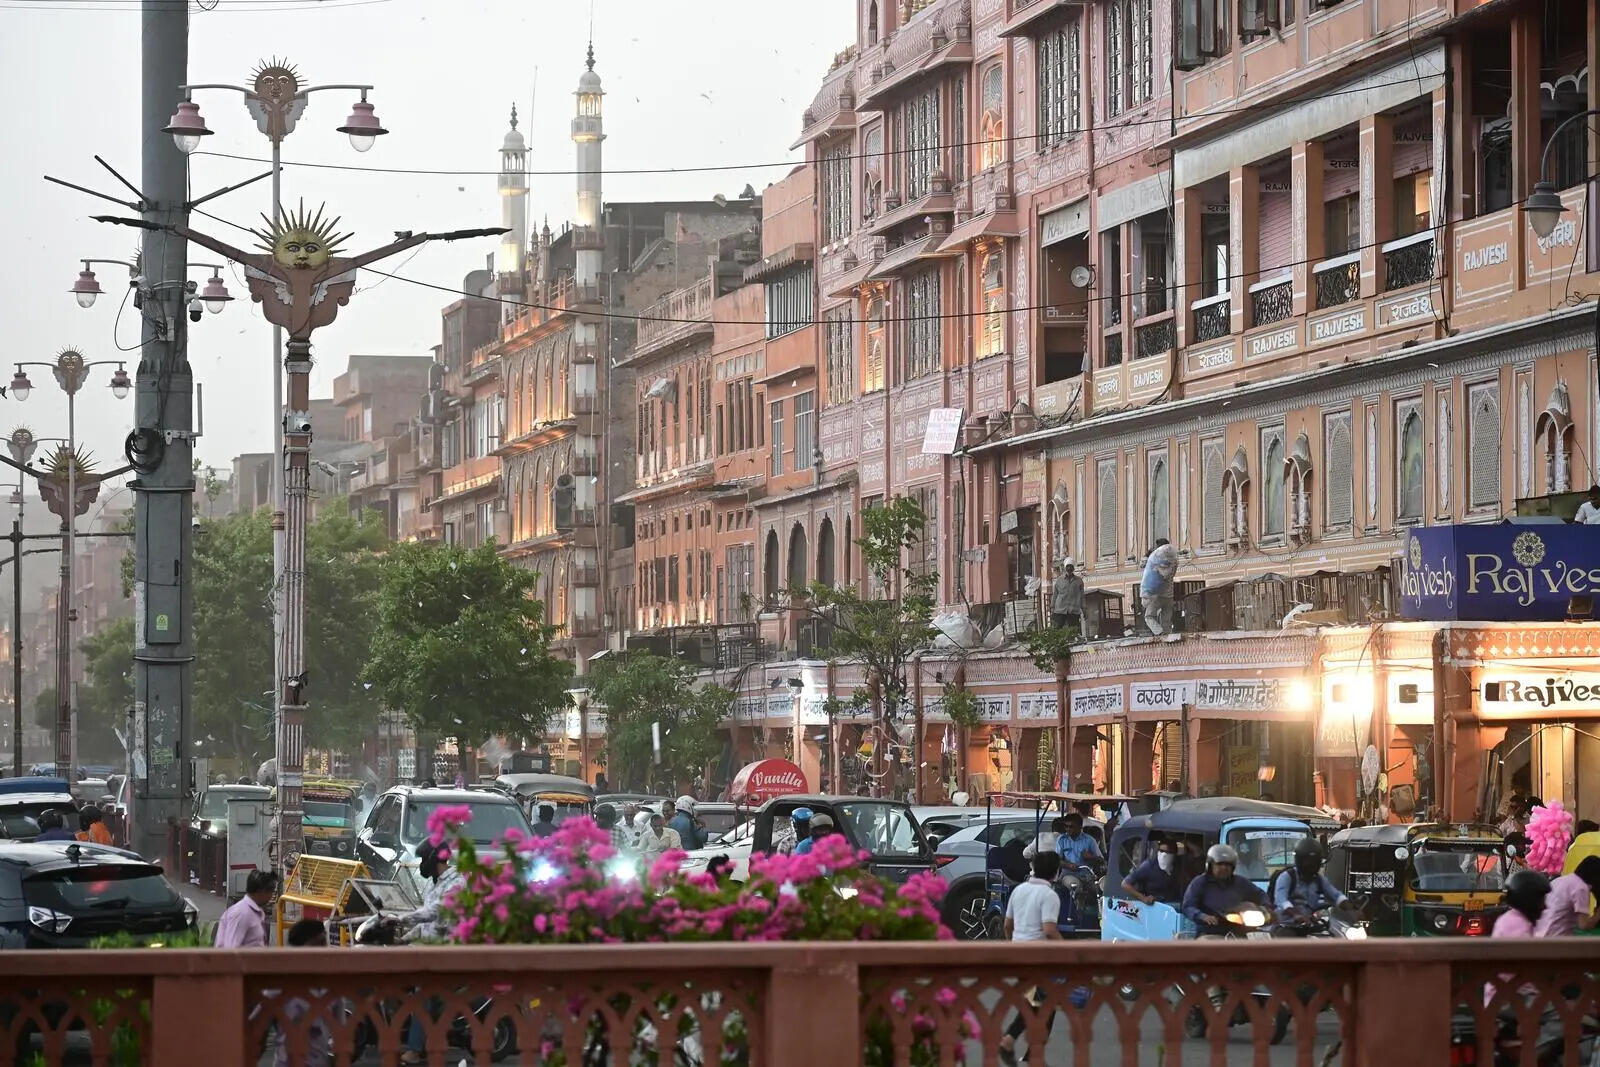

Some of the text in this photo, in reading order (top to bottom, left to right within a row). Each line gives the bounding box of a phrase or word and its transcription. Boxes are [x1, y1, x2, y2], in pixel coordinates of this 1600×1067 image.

[1265, 182, 1291, 191] RAJV
[1463, 241, 1508, 272] RAJVESH
[1315, 313, 1364, 339] RAJVESH
[1252, 329, 1296, 355] RAJVESH
[1198, 348, 1233, 369] राजवेश
[1133, 368, 1163, 388] RAJVESH
[1399, 556, 1454, 609] Rajvesh
[751, 771, 803, 788] Vanilla
